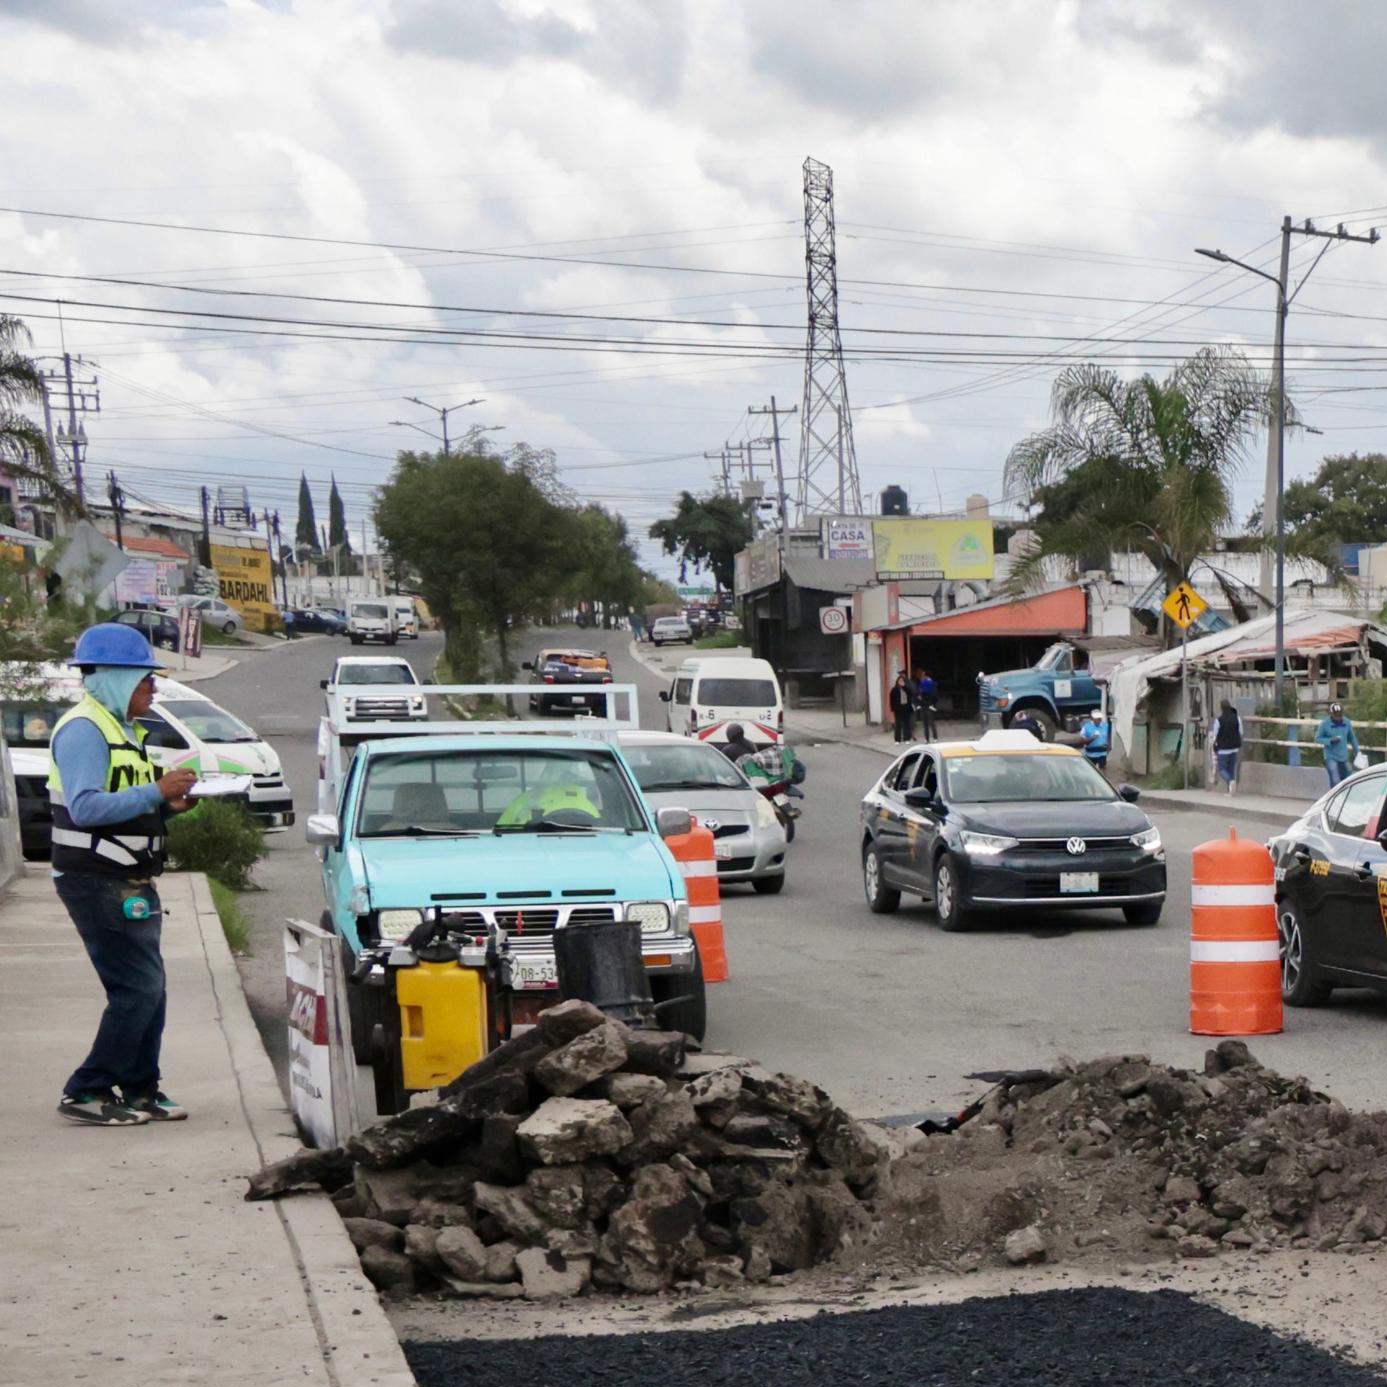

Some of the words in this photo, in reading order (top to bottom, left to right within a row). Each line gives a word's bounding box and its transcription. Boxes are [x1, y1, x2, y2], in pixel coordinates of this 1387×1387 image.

[831, 531, 865, 541] CASA
[219, 580, 270, 604] BARDAHL
[827, 613, 840, 622] 30
